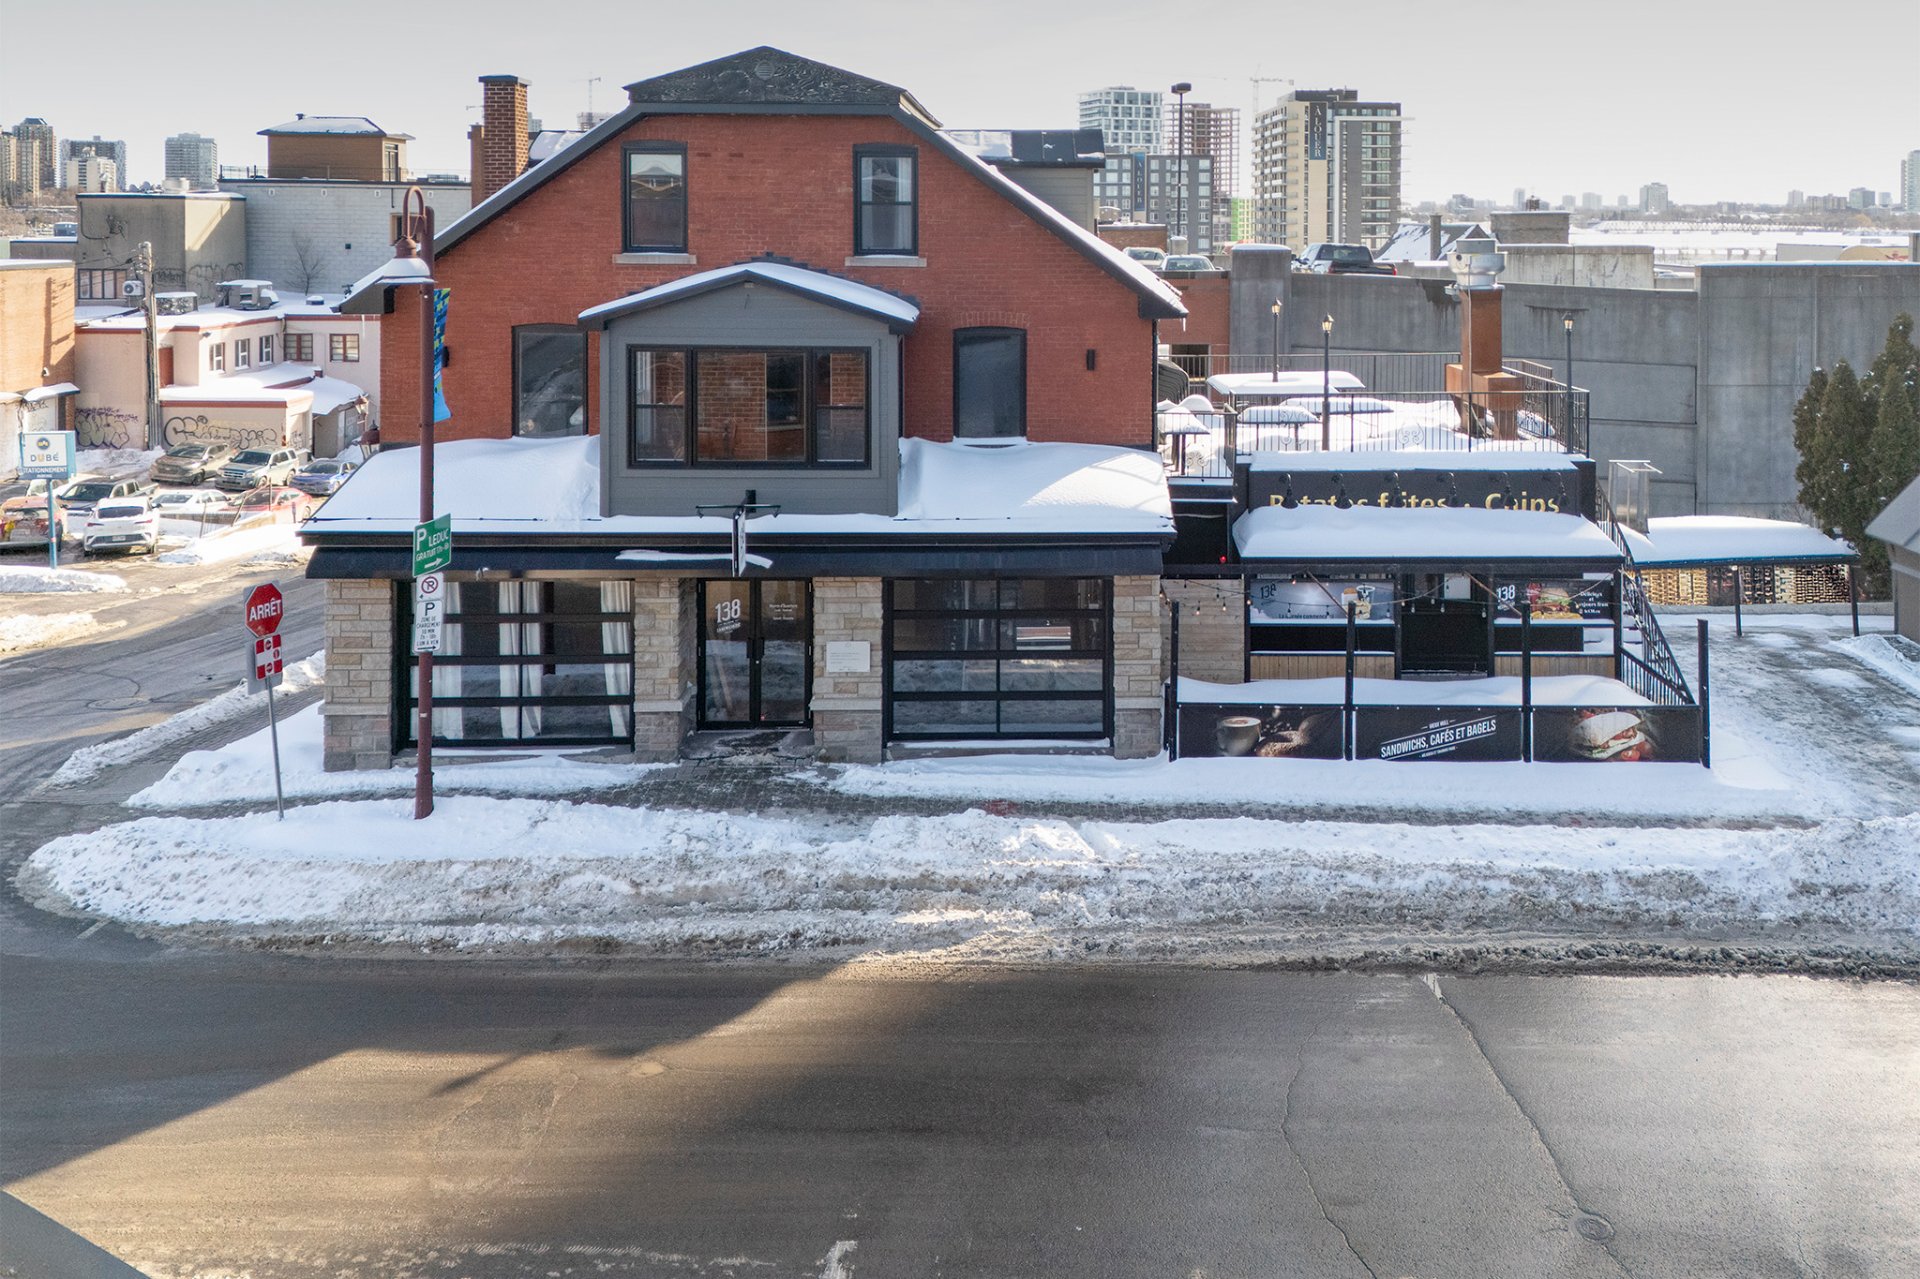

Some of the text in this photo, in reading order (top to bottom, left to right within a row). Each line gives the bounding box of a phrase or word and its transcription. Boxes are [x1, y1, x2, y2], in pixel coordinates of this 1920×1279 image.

[1314, 117, 1322, 157] LOUER
[30, 452, 59, 462] DUBÉ
[416, 527, 449, 551] P LEDUC
[1496, 584, 1515, 602] 138
[249, 597, 282, 622] ARRÊT
[425, 602, 435, 616] P
[715, 599, 741, 623] 138
[1381, 737, 1429, 758] SANDWICHS,
[1430, 728, 1454, 745] CAFÉS
[1455, 727, 1465, 739] ET
[1467, 719, 1497, 737] BAGELS
